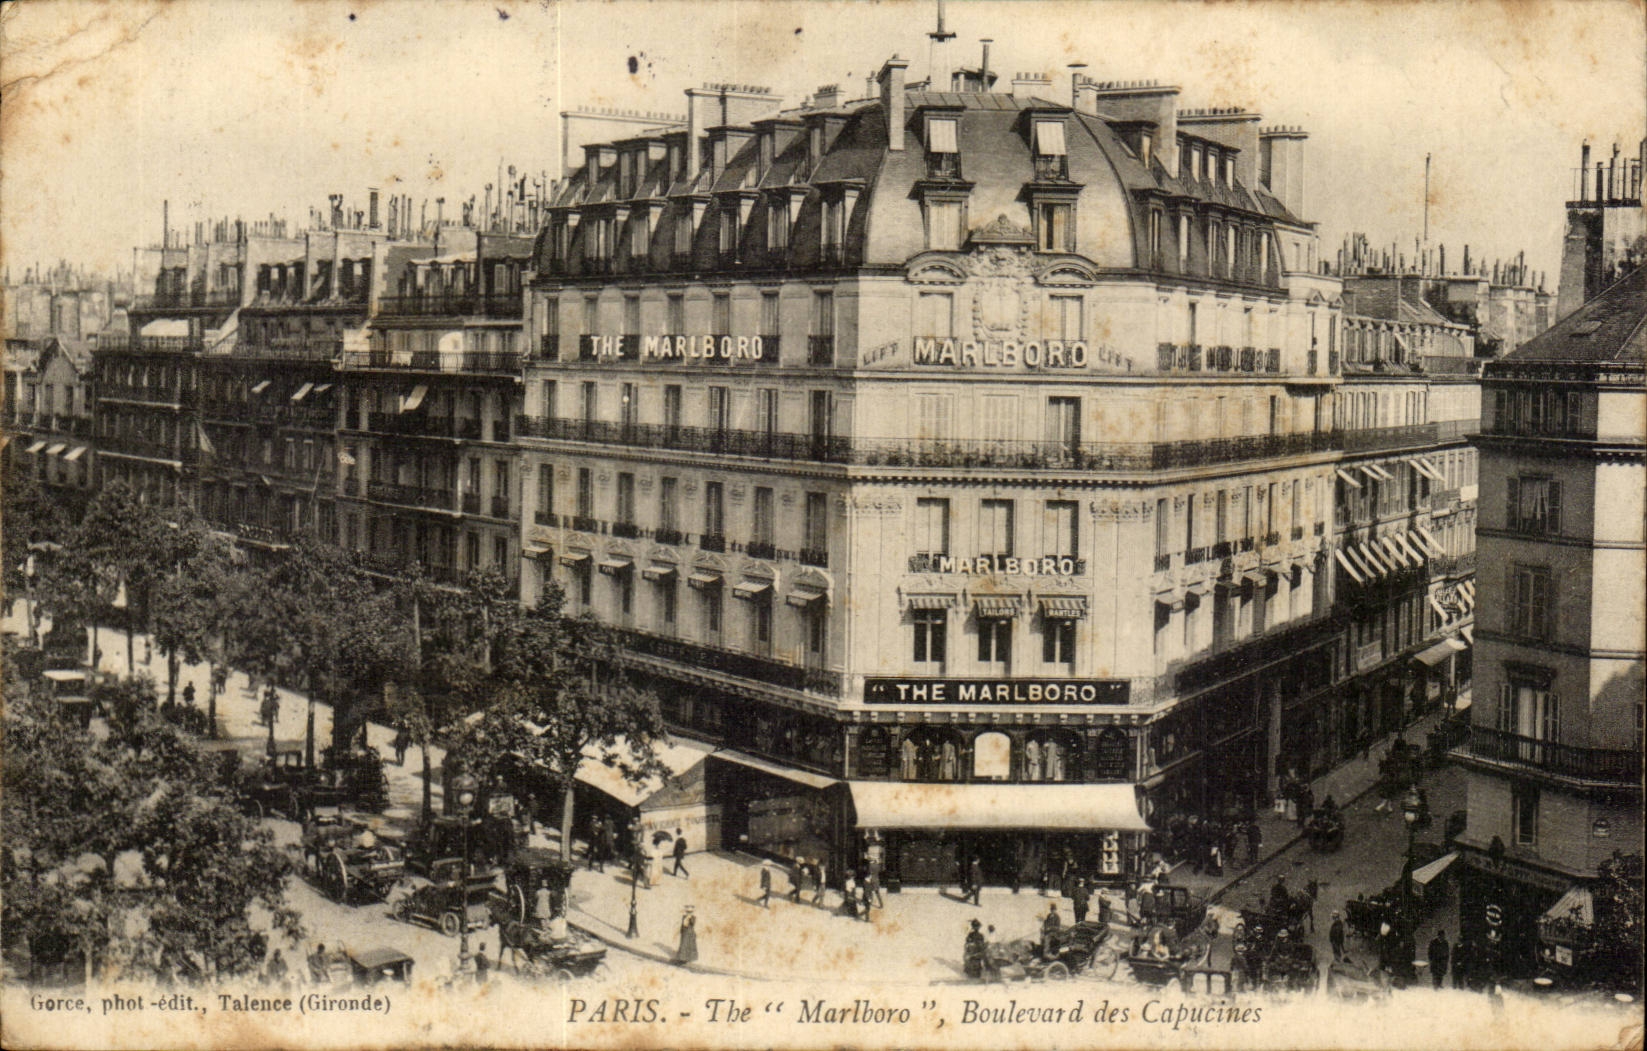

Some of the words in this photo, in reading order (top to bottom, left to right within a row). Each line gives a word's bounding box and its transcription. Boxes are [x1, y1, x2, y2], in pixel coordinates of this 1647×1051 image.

[590, 335, 625, 357] THE
[643, 335, 763, 360] MARLBORO
[914, 338, 1088, 367] MARLBORO
[939, 555, 1074, 576] MARLBORO
[896, 683, 946, 701] THE
[958, 683, 1097, 702] MARLBORO
